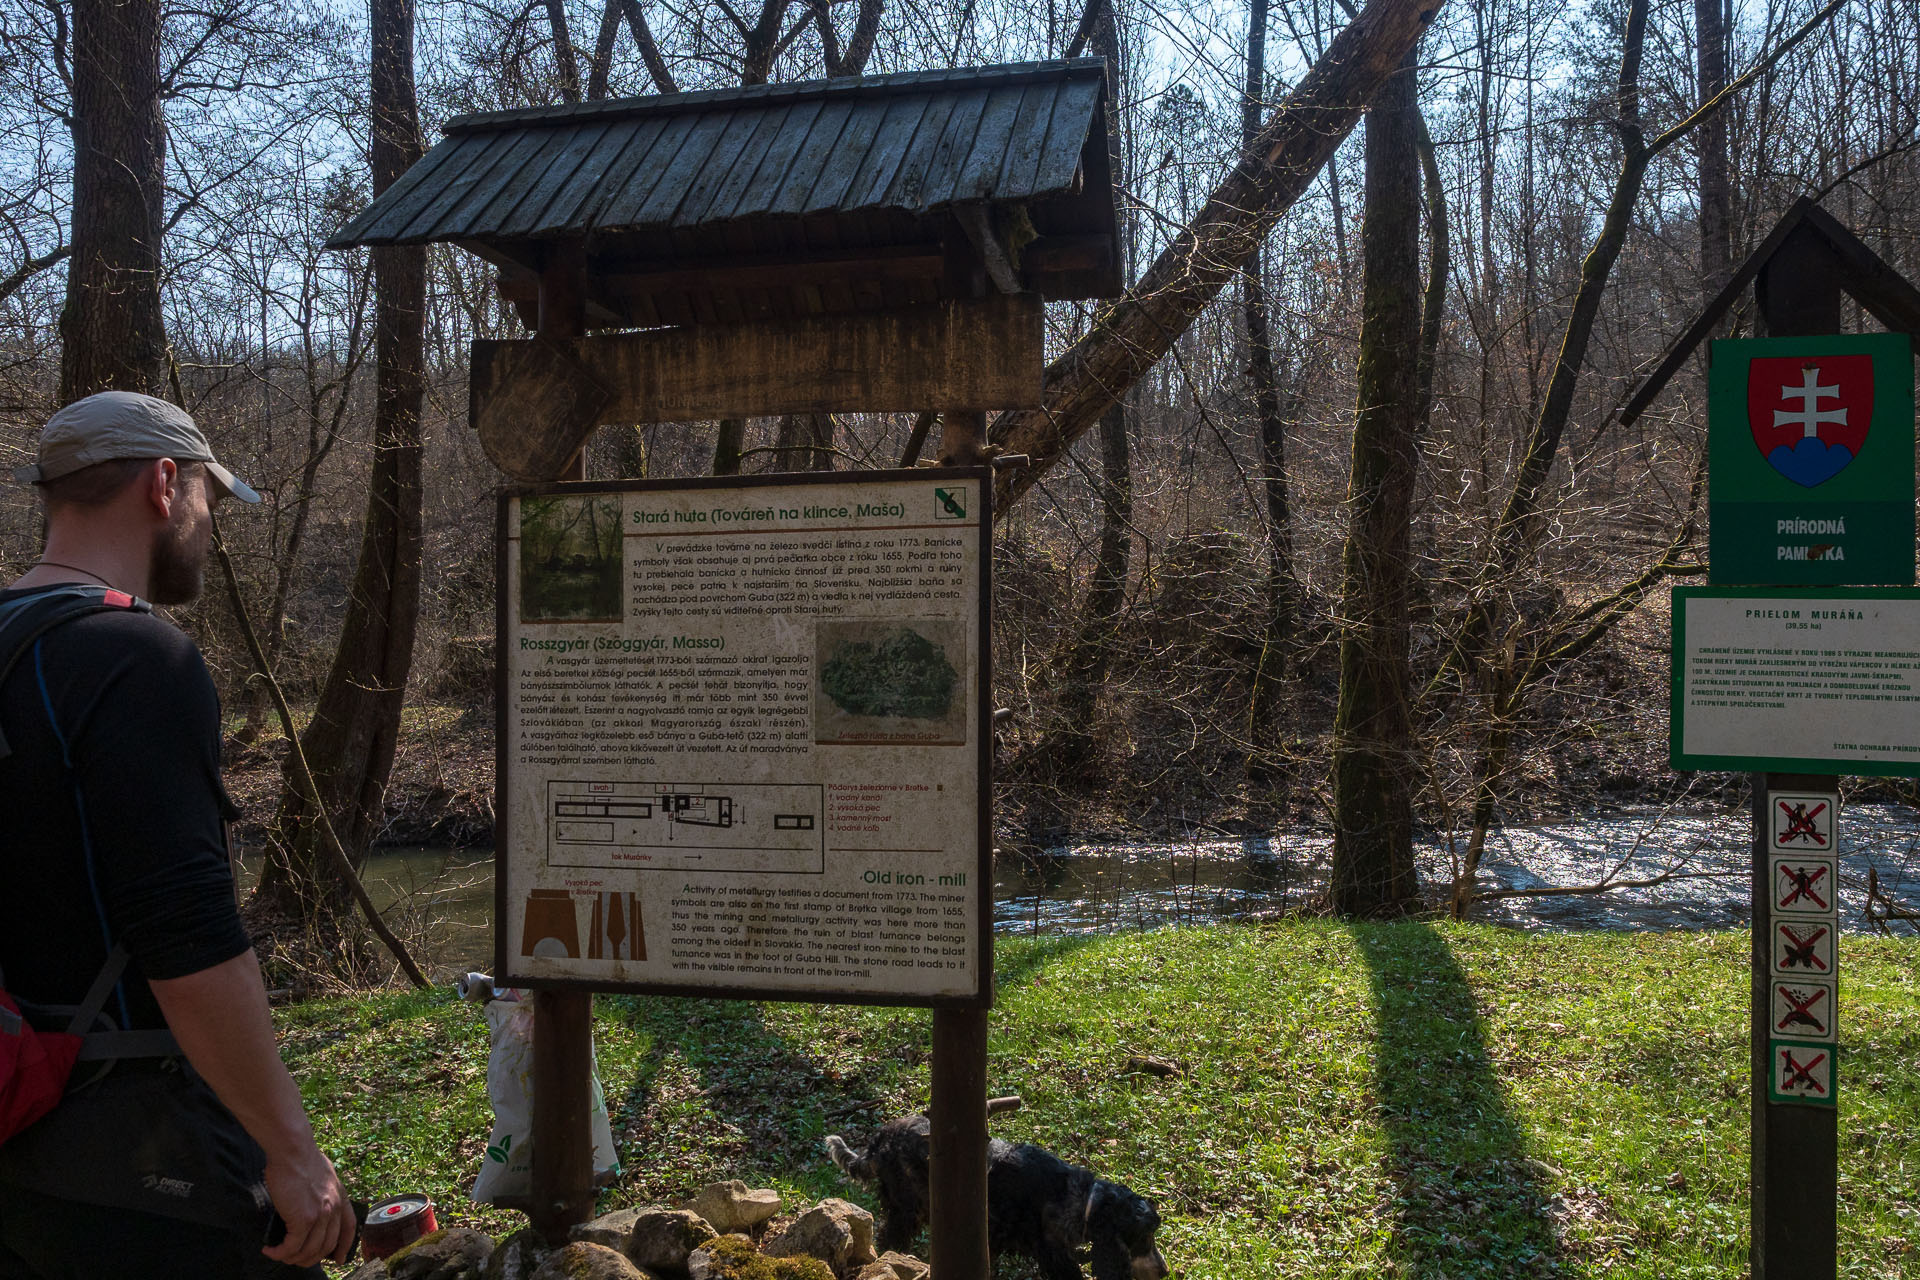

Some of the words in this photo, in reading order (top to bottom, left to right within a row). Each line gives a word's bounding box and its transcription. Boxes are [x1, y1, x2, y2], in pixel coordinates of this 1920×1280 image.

[944, 493, 956, 514] 6
[634, 510, 669, 523] Stará
[675, 509, 706, 522] huta
[711, 508, 774, 524] (Továreň
[780, 511, 798, 520] na
[804, 505, 853, 522] klince,
[857, 504, 904, 520] Maša)
[1777, 516, 1846, 534] PRÍRODNÁ
[1777, 546, 1844, 561] PAMIKA
[1746, 610, 1800, 619] PRIELOM
[1812, 610, 1864, 620] MURÁŇA
[1810, 623, 1822, 631] ha)
[520, 637, 590, 653] Rosszgyár
[673, 636, 725, 652] Massa)
[863, 872, 892, 884] Old
[896, 873, 925, 885] iron
[938, 874, 966, 886] mill
[683, 884, 716, 897] Activity
[718, 885, 727, 895] of
[729, 886, 776, 899] metallurgy
[778, 888, 812, 898] testifies
[822, 889, 870, 899] document
[872, 890, 893, 900] from
[897, 891, 916, 901] 1773.
[920, 892, 936, 902] The
[938, 893, 964, 903] miner
[671, 896, 706, 909] symbols
[728, 898, 747, 908] also
[766, 899, 780, 909] the
[784, 900, 799, 910] first
[804, 901, 832, 913] stamp
[836, 902, 845, 912] of
[881, 904, 912, 916] village
[916, 905, 938, 915] from
[943, 906, 966, 918] 1655,
[671, 910, 690, 920] thus
[694, 911, 709, 921] the
[713, 912, 744, 924] mining
[748, 912, 767, 923] and
[771, 914, 820, 926] metallurgy
[825, 915, 858, 928] activity
[887, 917, 909, 927] here
[943, 919, 966, 929] than
[671, 939, 703, 949] among
[706, 937, 720, 947] the
[723, 938, 751, 948] oldest
[754, 939, 762, 949] in
[765, 940, 804, 950] Slovakia.
[808, 941, 823, 951] The
[826, 942, 860, 952] nearest
[864, 943, 882, 953] iron
[884, 944, 908, 954] mine
[911, 944, 920, 954] to
[923, 945, 938, 955] the
[942, 946, 965, 956] blast
[672, 960, 690, 971] with
[692, 961, 706, 971] the
[708, 962, 735, 972] visible
[737, 963, 772, 973] remains
[774, 964, 782, 974] in
[784, 965, 804, 975] front
[806, 965, 816, 975] of
[817, 966, 832, 976] the
[834, 967, 873, 977] iron-mill.
[734, 950, 742, 960] in
[744, 951, 760, 961] the
[762, 952, 780, 962] foot
[783, 952, 793, 962] of
[795, 953, 822, 963] Guba
[824, 954, 840, 964] Hill.
[844, 955, 860, 965] The
[863, 956, 889, 966] stone
[891, 957, 914, 967] road
[917, 958, 944, 968] leads
[946, 959, 956, 969] to
[959, 959, 966, 969] it
